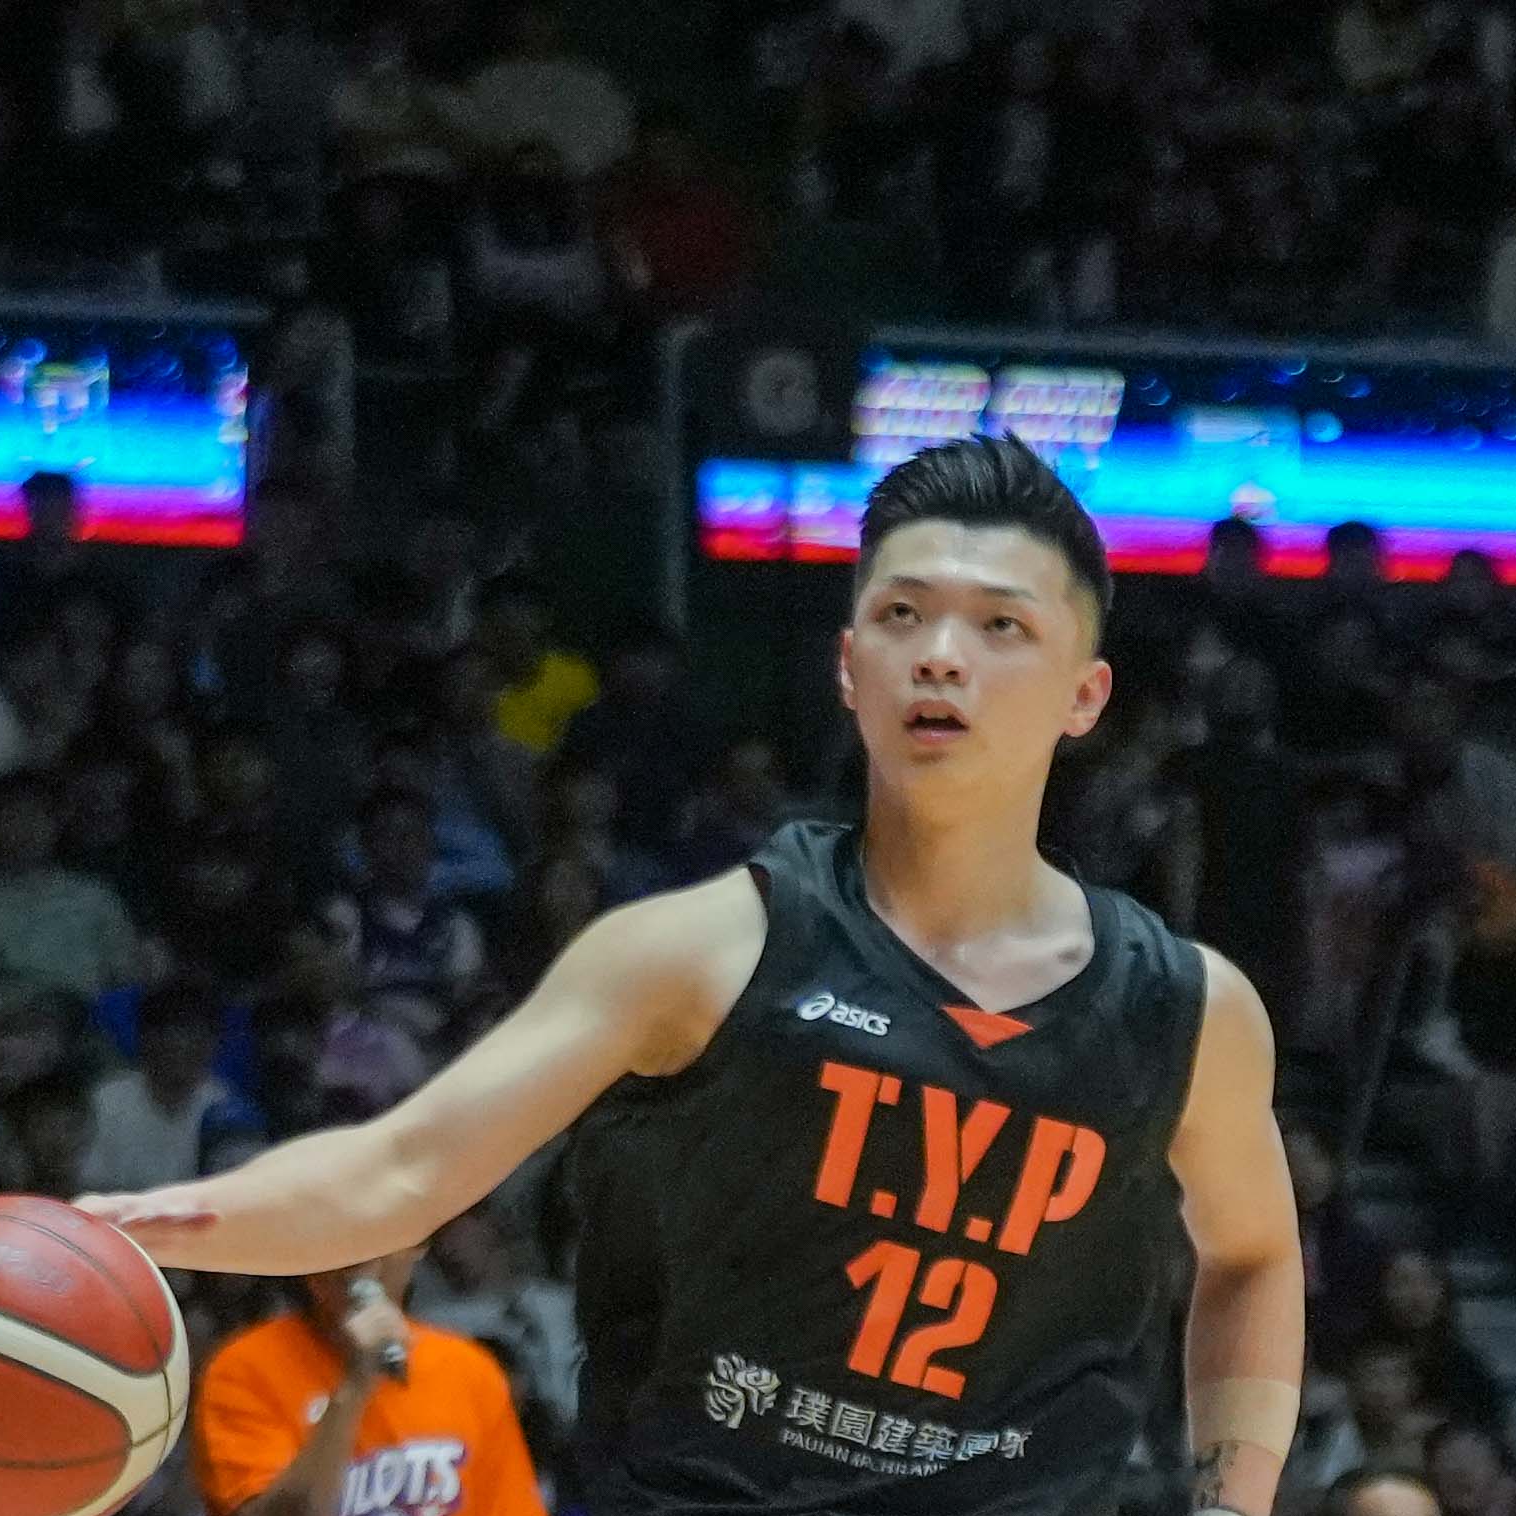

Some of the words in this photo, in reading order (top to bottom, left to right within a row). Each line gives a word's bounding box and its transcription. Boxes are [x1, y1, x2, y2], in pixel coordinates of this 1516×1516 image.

[829, 1001, 891, 1037] asics
[815, 1061, 1107, 1256] T.Y.P
[845, 1240, 999, 1400] 12
